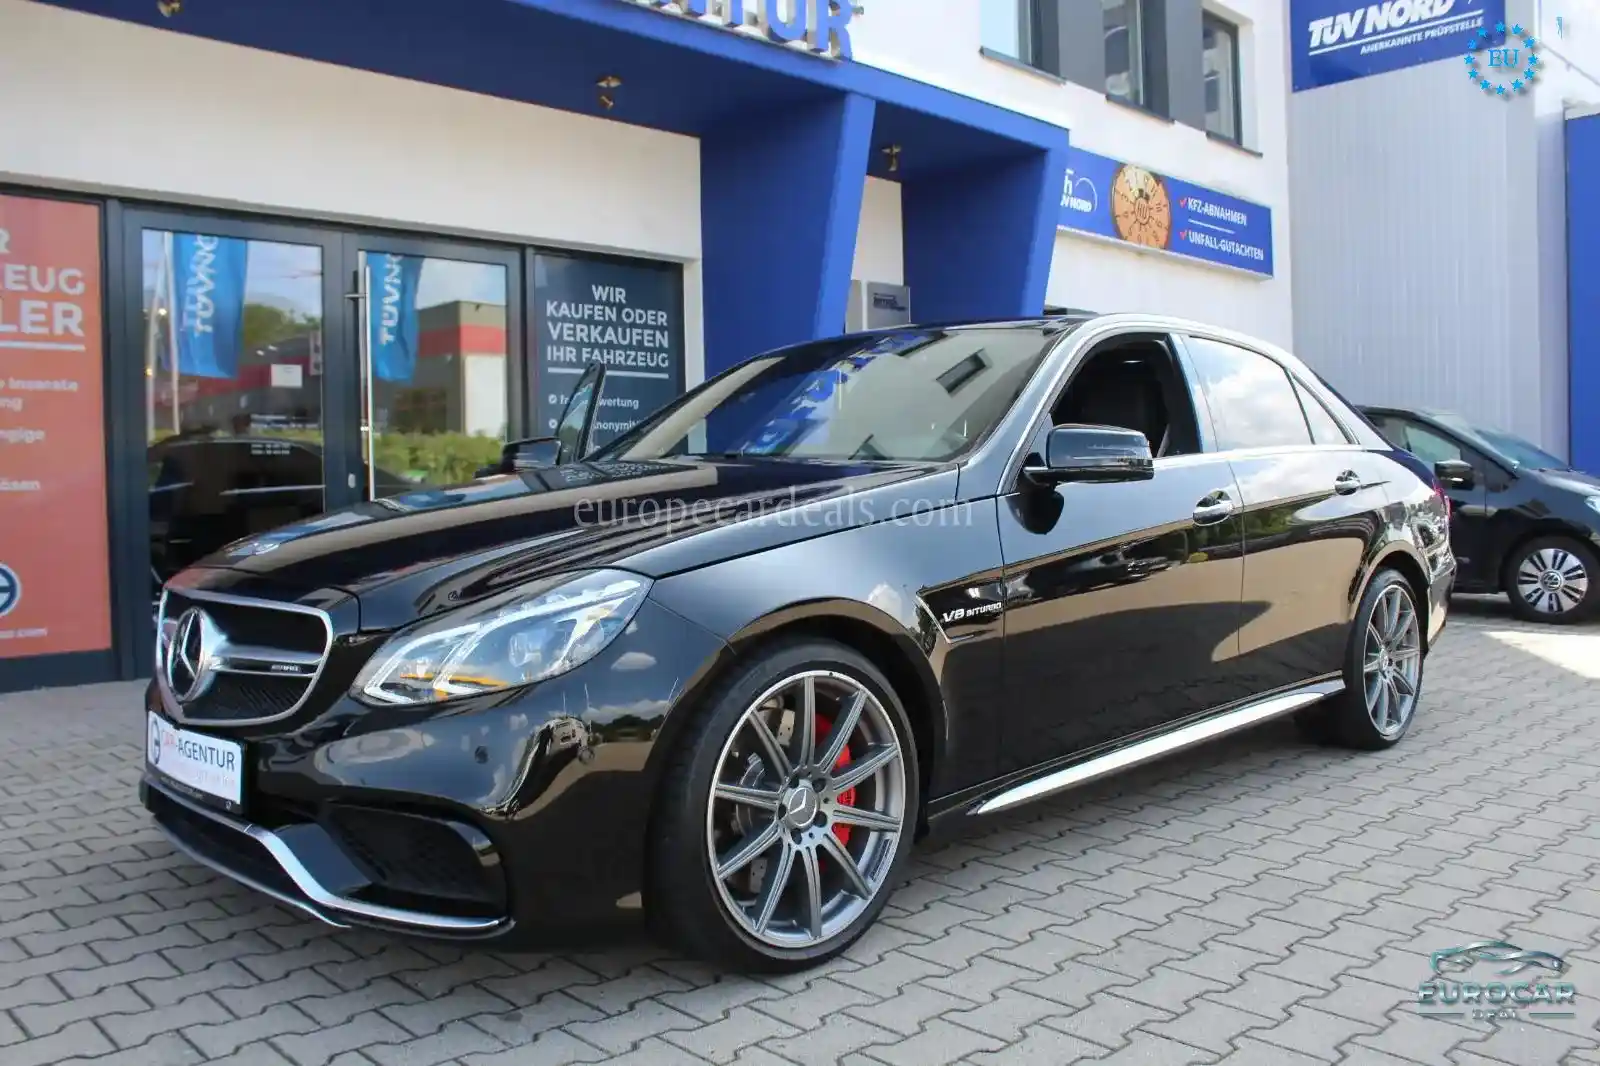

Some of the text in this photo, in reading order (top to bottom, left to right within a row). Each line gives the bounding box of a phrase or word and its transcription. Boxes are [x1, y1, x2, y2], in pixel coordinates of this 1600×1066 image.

[1188, 197, 1247, 226] KFZ-ABNAHMEN
[1189, 230, 1264, 261] UNFALL-GUTACHTEN
[591, 284, 626, 303] WIR
[546, 300, 668, 327] KAUFEN ODER
[547, 321, 669, 348] VERKAUFEN
[547, 346, 669, 368] IHR FAHRZEUG
[599, 397, 639, 409] wertung
[942, 608, 965, 623] V8
